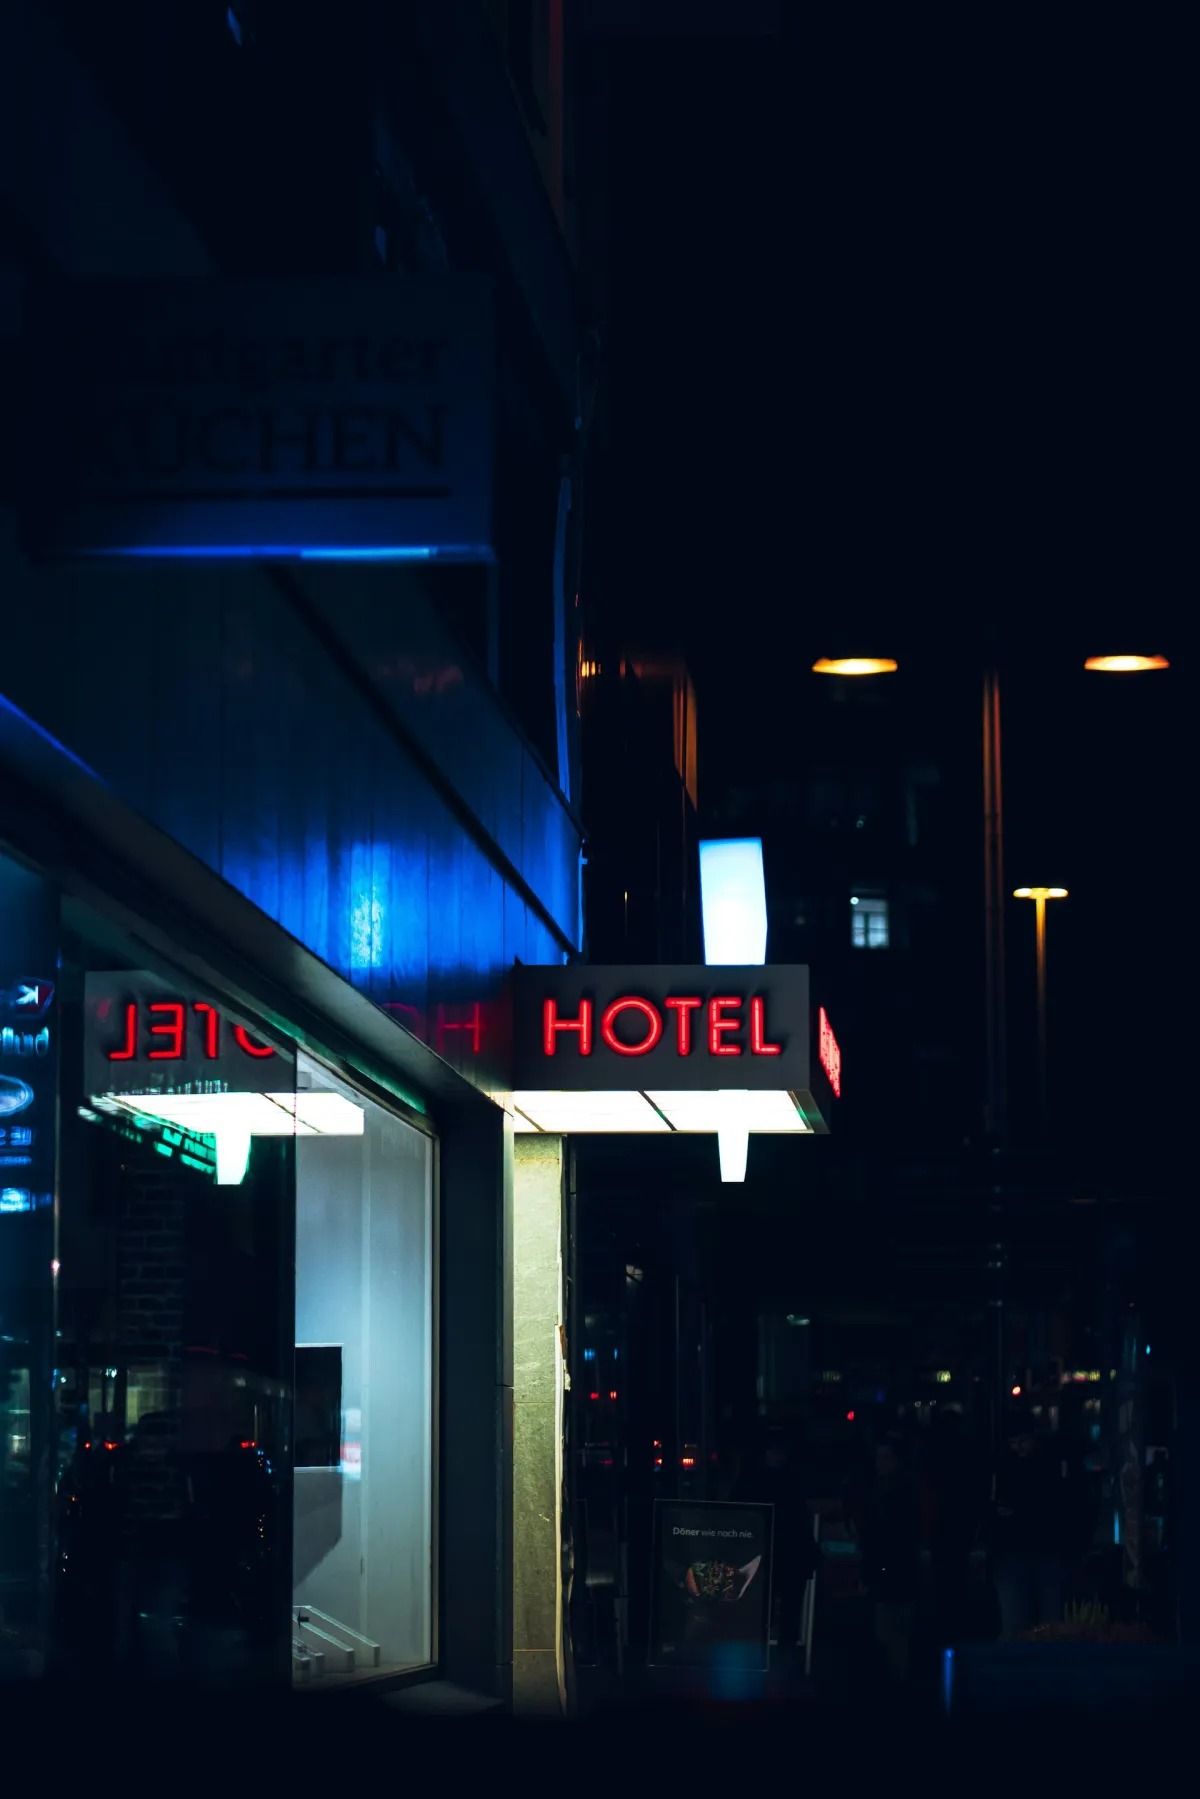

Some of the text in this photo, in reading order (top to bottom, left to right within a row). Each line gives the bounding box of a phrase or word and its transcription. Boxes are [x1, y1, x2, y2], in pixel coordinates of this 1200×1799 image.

[543, 996, 782, 1056] HOTEL
[672, 1526, 700, 1536] Döner
[701, 1528, 716, 1537] wie
[717, 1529, 738, 1539] noch
